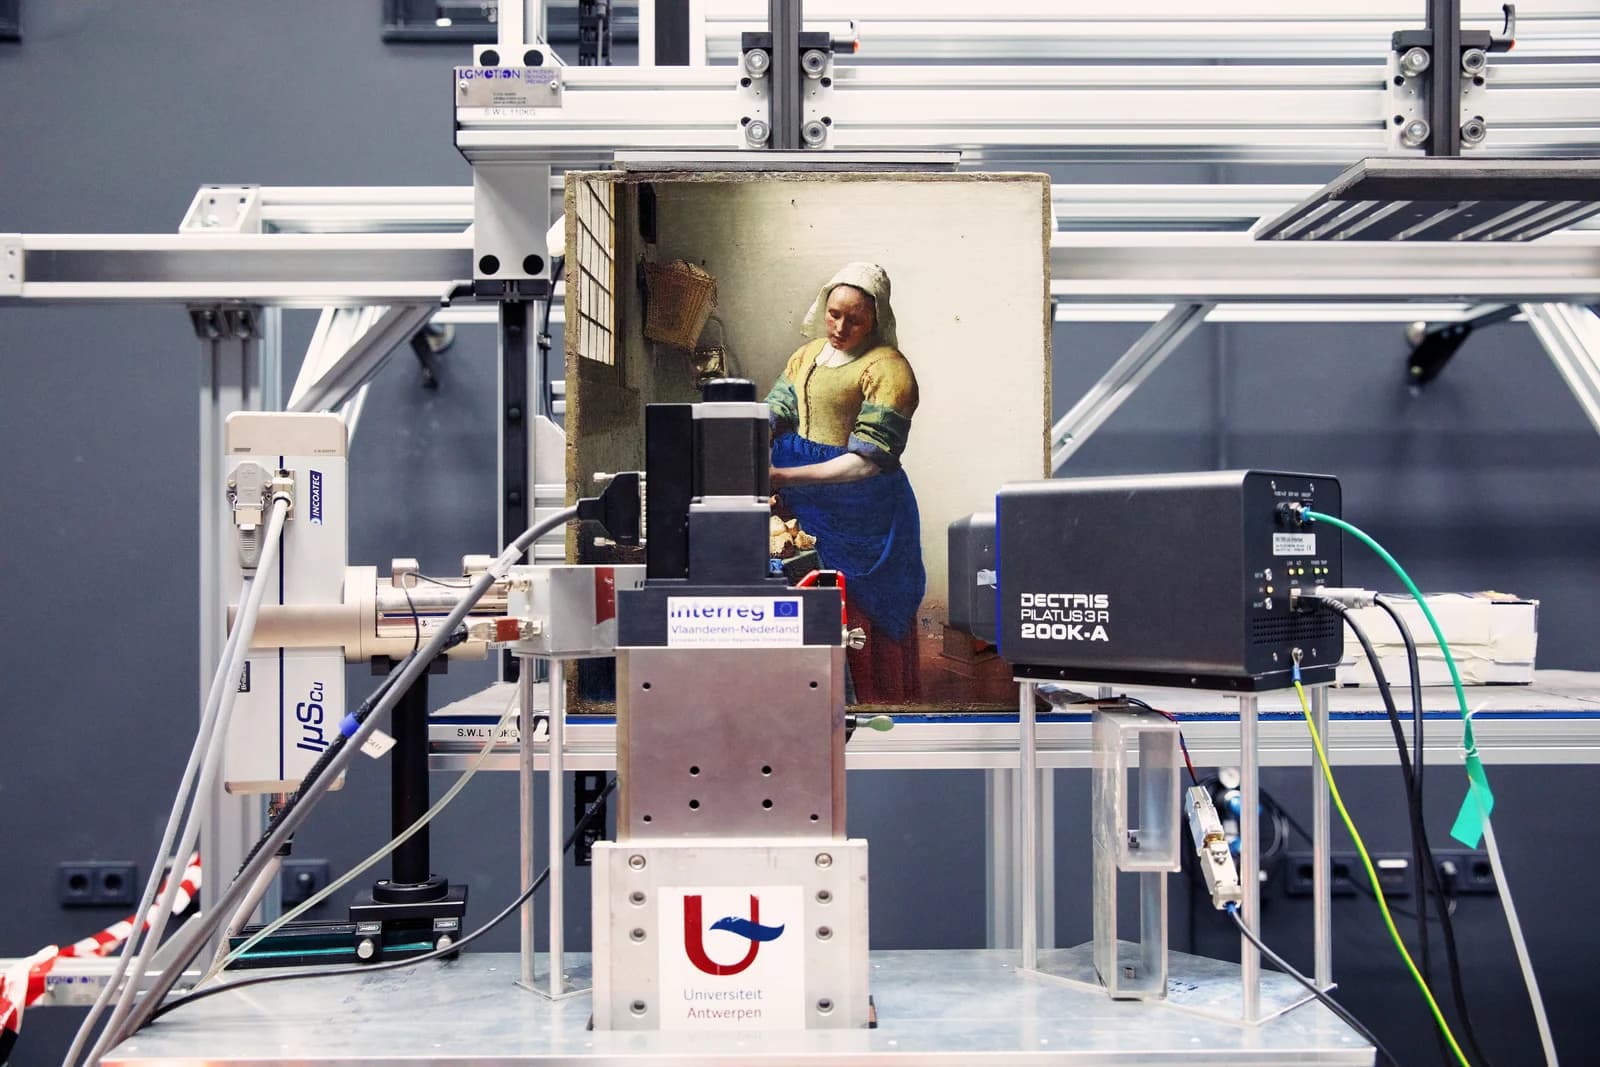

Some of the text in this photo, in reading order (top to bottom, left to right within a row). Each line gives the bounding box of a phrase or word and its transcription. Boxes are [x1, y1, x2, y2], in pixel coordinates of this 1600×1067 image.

[312, 474, 320, 517] INCOATEC
[1020, 593, 1109, 609] DECTRIS
[671, 624, 800, 635] Vlaanderen-Nederland
[683, 988, 763, 1001] Universiteit
[687, 1007, 762, 1022] Antwerpen
